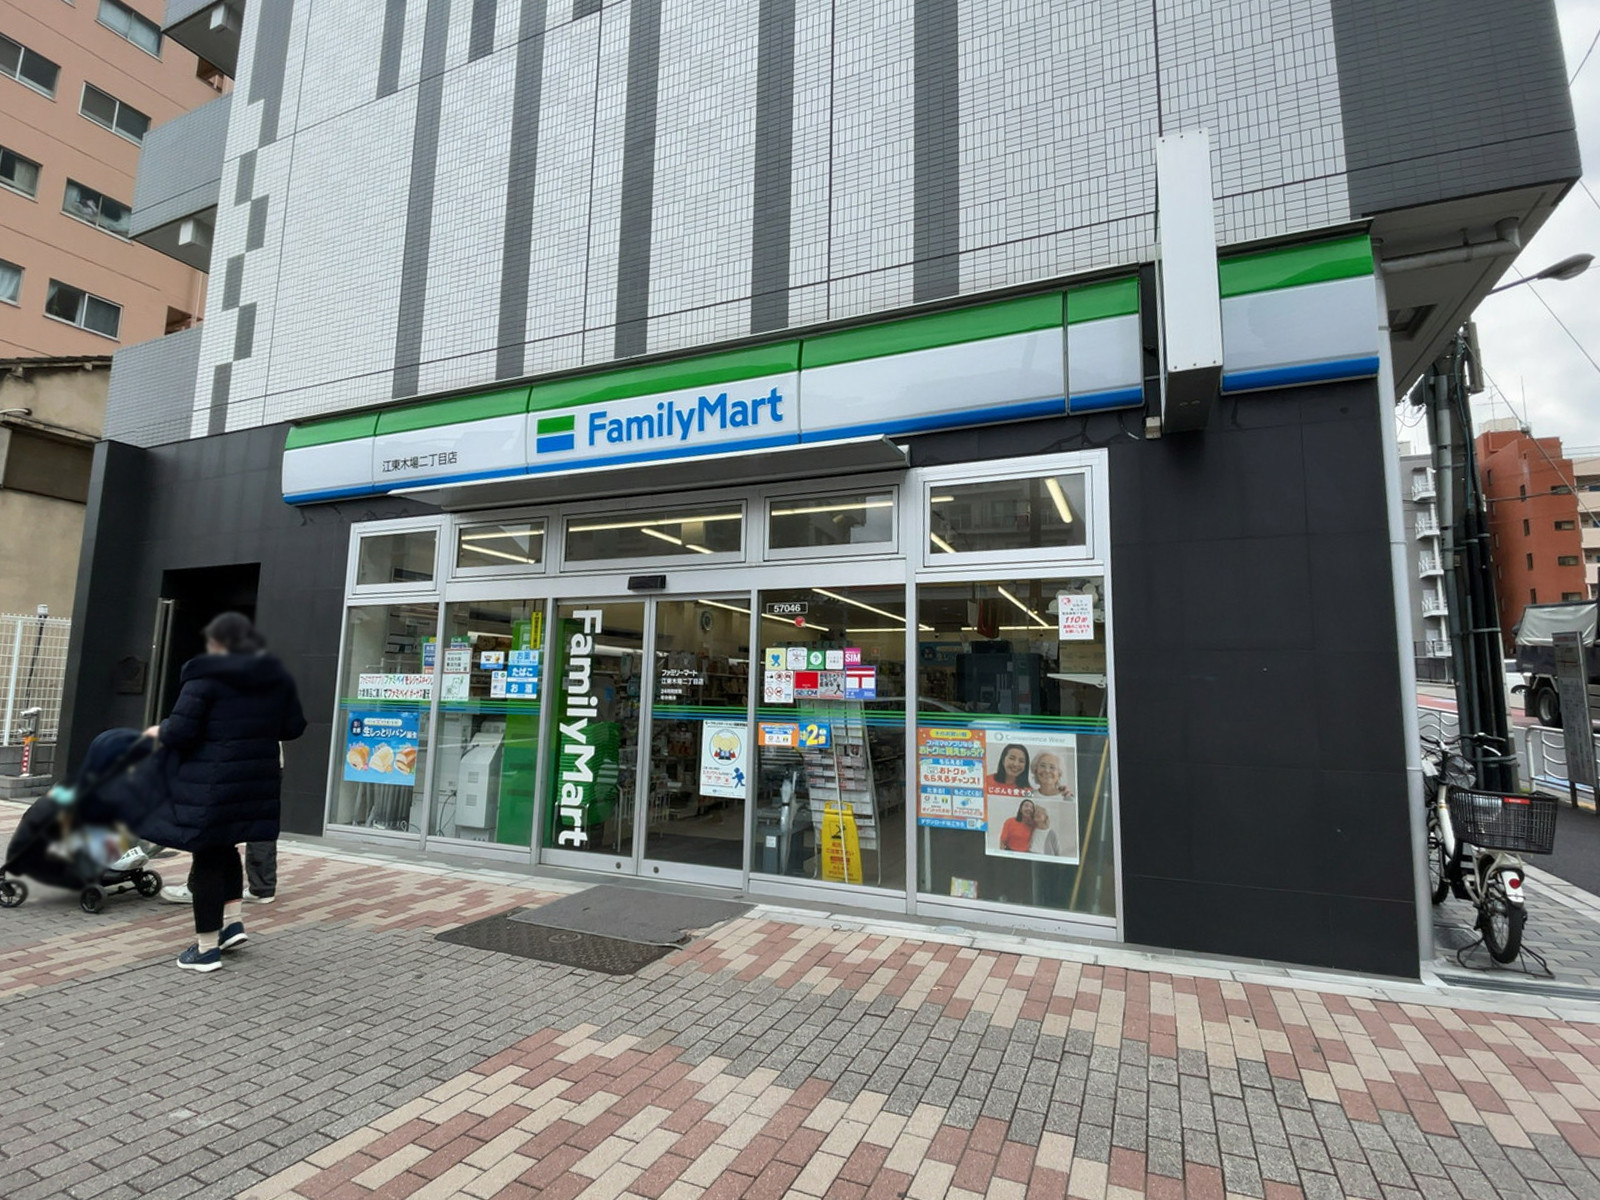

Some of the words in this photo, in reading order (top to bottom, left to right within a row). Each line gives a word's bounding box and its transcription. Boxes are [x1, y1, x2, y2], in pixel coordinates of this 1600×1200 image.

[588, 386, 784, 446] FamilyMart
[382, 450, 458, 472] 江東木場二丁目店
[773, 604, 801, 613] 57046
[844, 653, 861, 663] SIM
[511, 667, 534, 677] たばこ
[661, 669, 698, 677] ファミリーマート
[558, 609, 603, 847] FamilyMart
